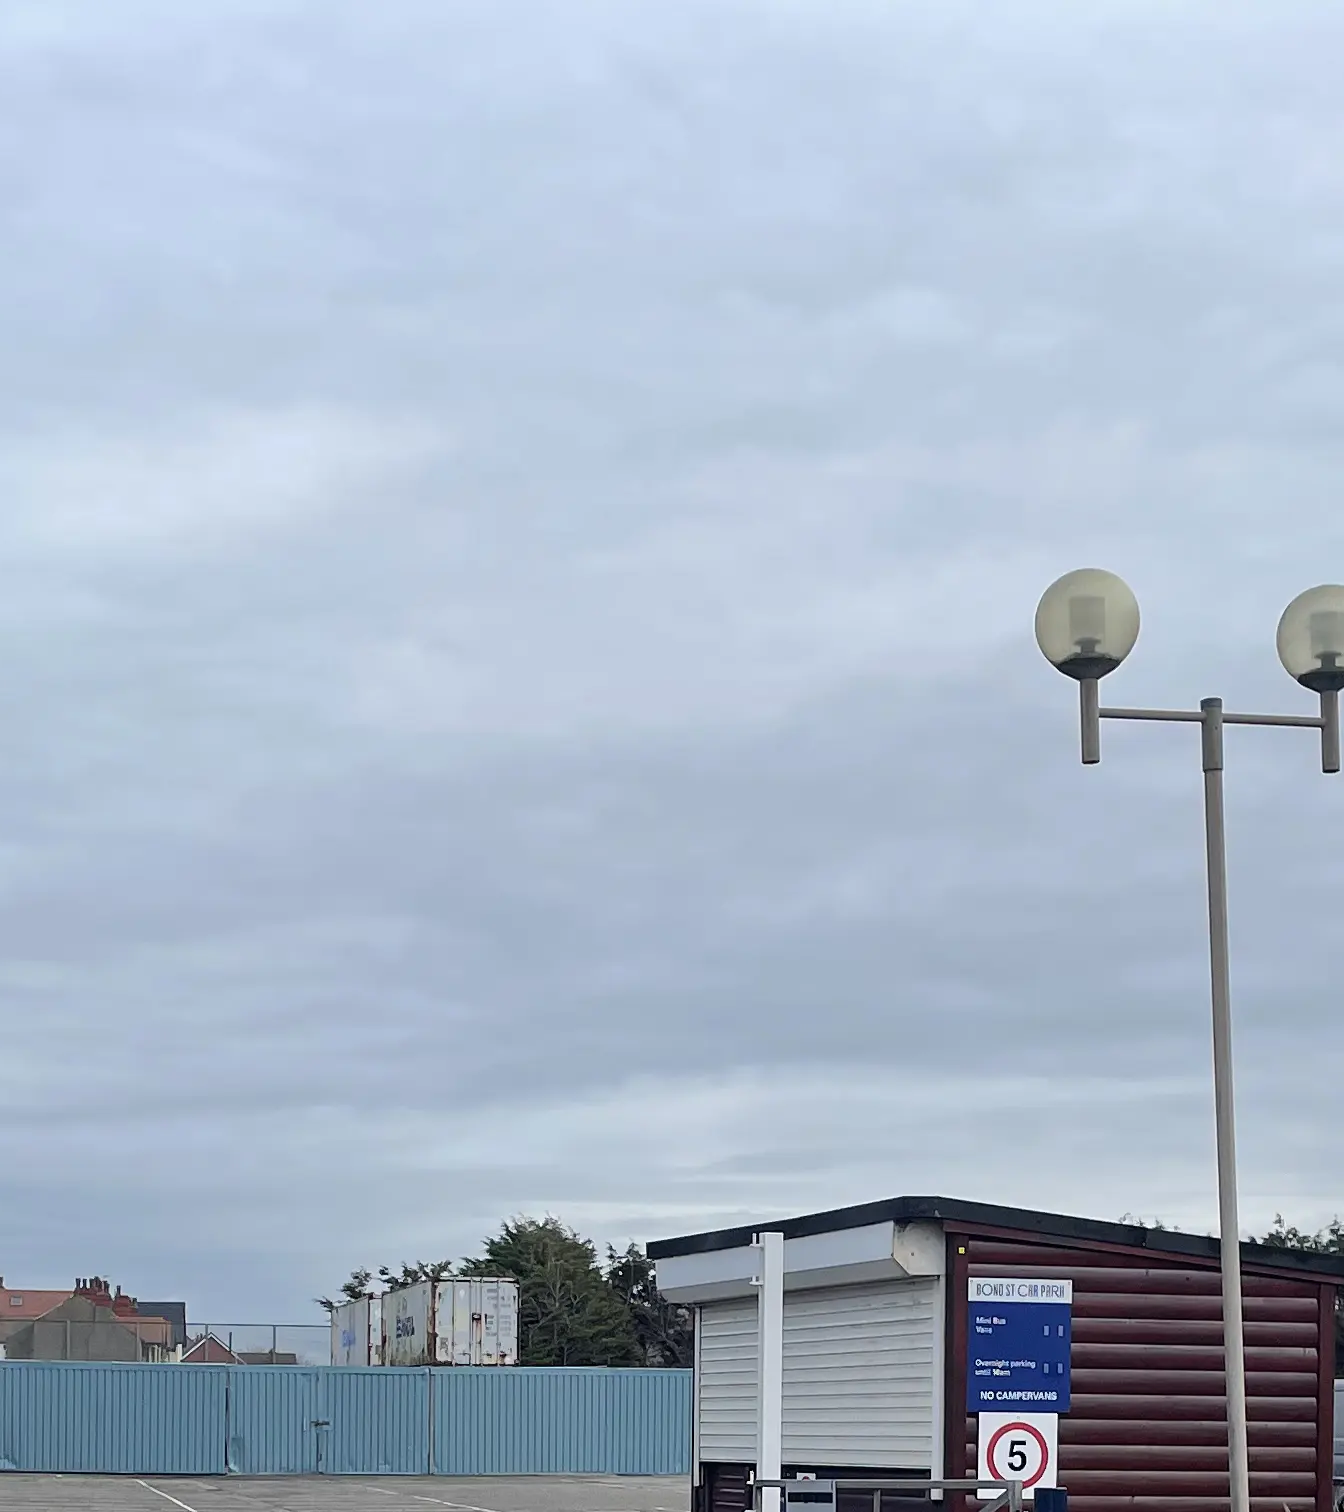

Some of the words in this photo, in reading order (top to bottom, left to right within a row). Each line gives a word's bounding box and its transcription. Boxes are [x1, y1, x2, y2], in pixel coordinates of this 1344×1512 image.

[976, 1283, 1004, 1297] BOND
[1005, 1283, 1016, 1297] ST
[1017, 1284, 1039, 1297] CAR
[1040, 1284, 1065, 1298] PARK
[975, 1359, 1010, 1369] Overnight
[1010, 1360, 1036, 1369] parking
[980, 1390, 995, 1401] NO
[995, 1391, 1058, 1401] CAMPERVANS
[1007, 1440, 1027, 1472] 5
